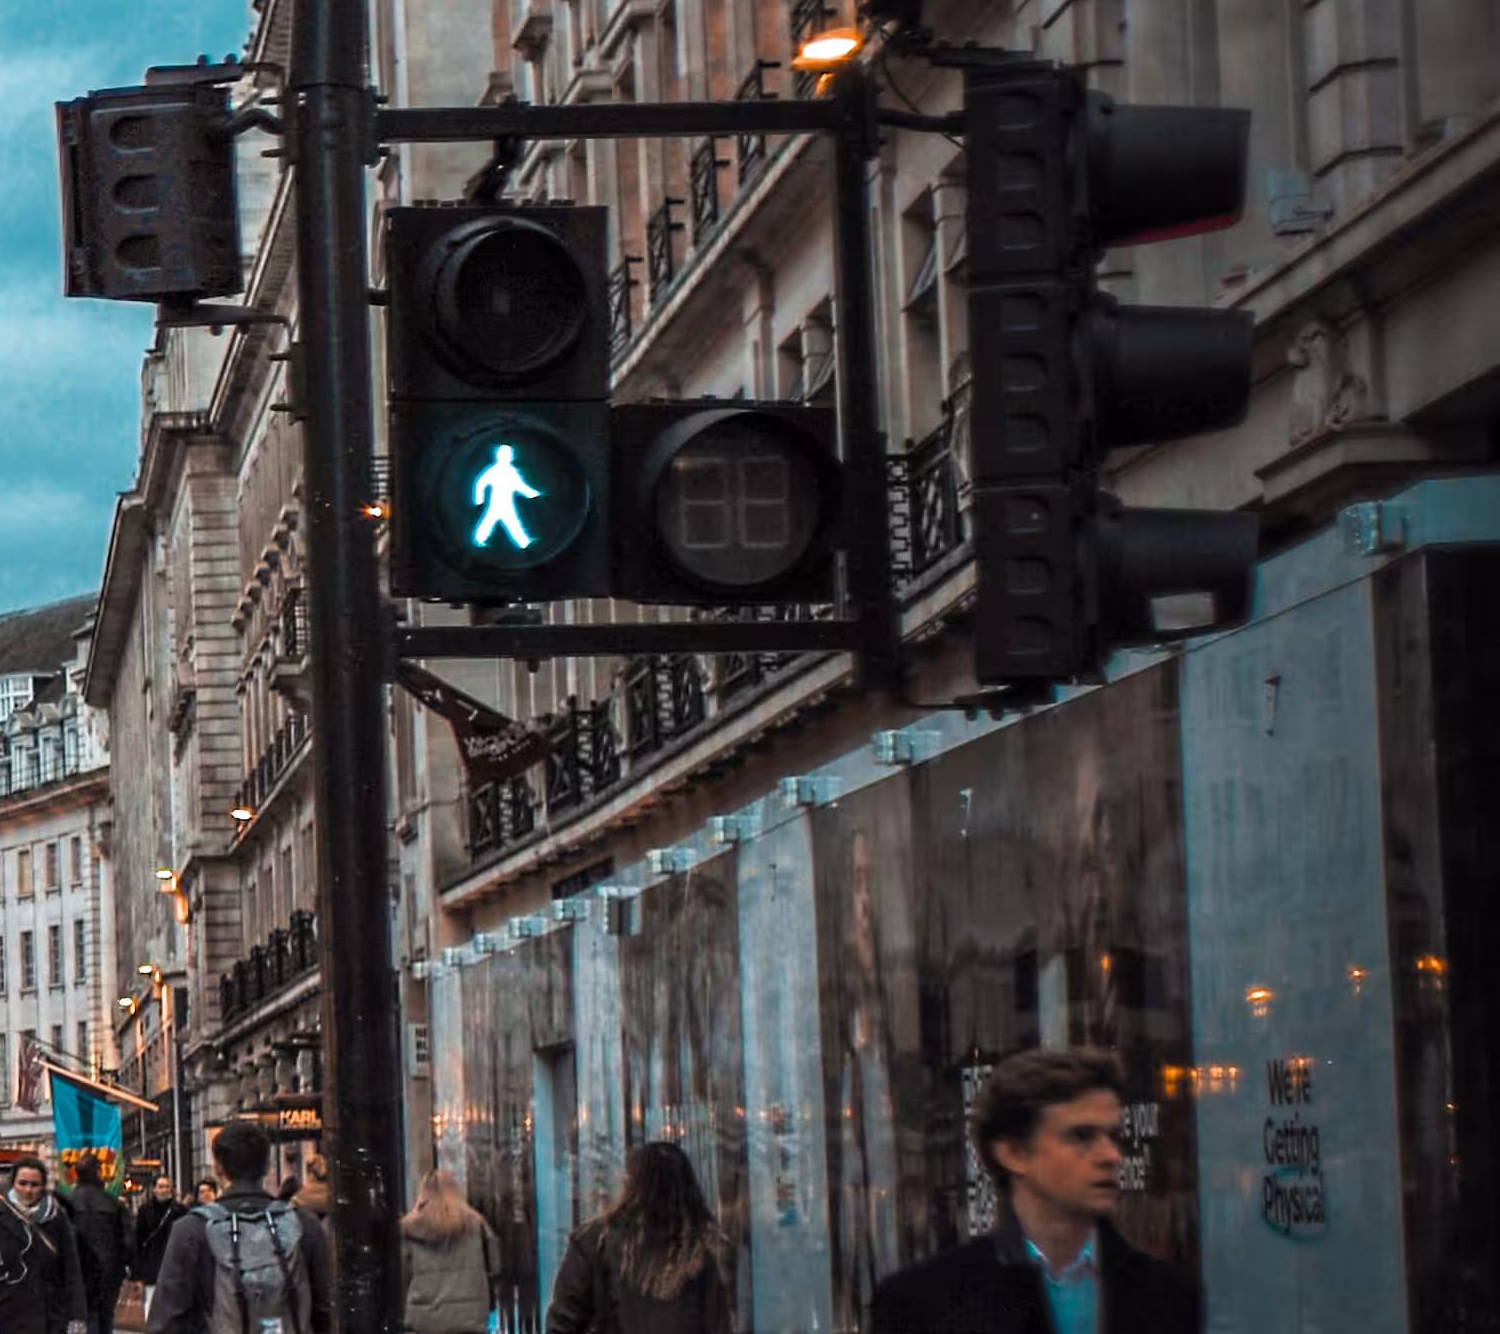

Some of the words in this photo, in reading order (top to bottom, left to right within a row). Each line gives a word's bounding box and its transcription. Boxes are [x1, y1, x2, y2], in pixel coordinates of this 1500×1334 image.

[280, 1109, 321, 1125] KARL
[1263, 1110, 1320, 1176] Getting
[1263, 1172, 1325, 1236] Physical
